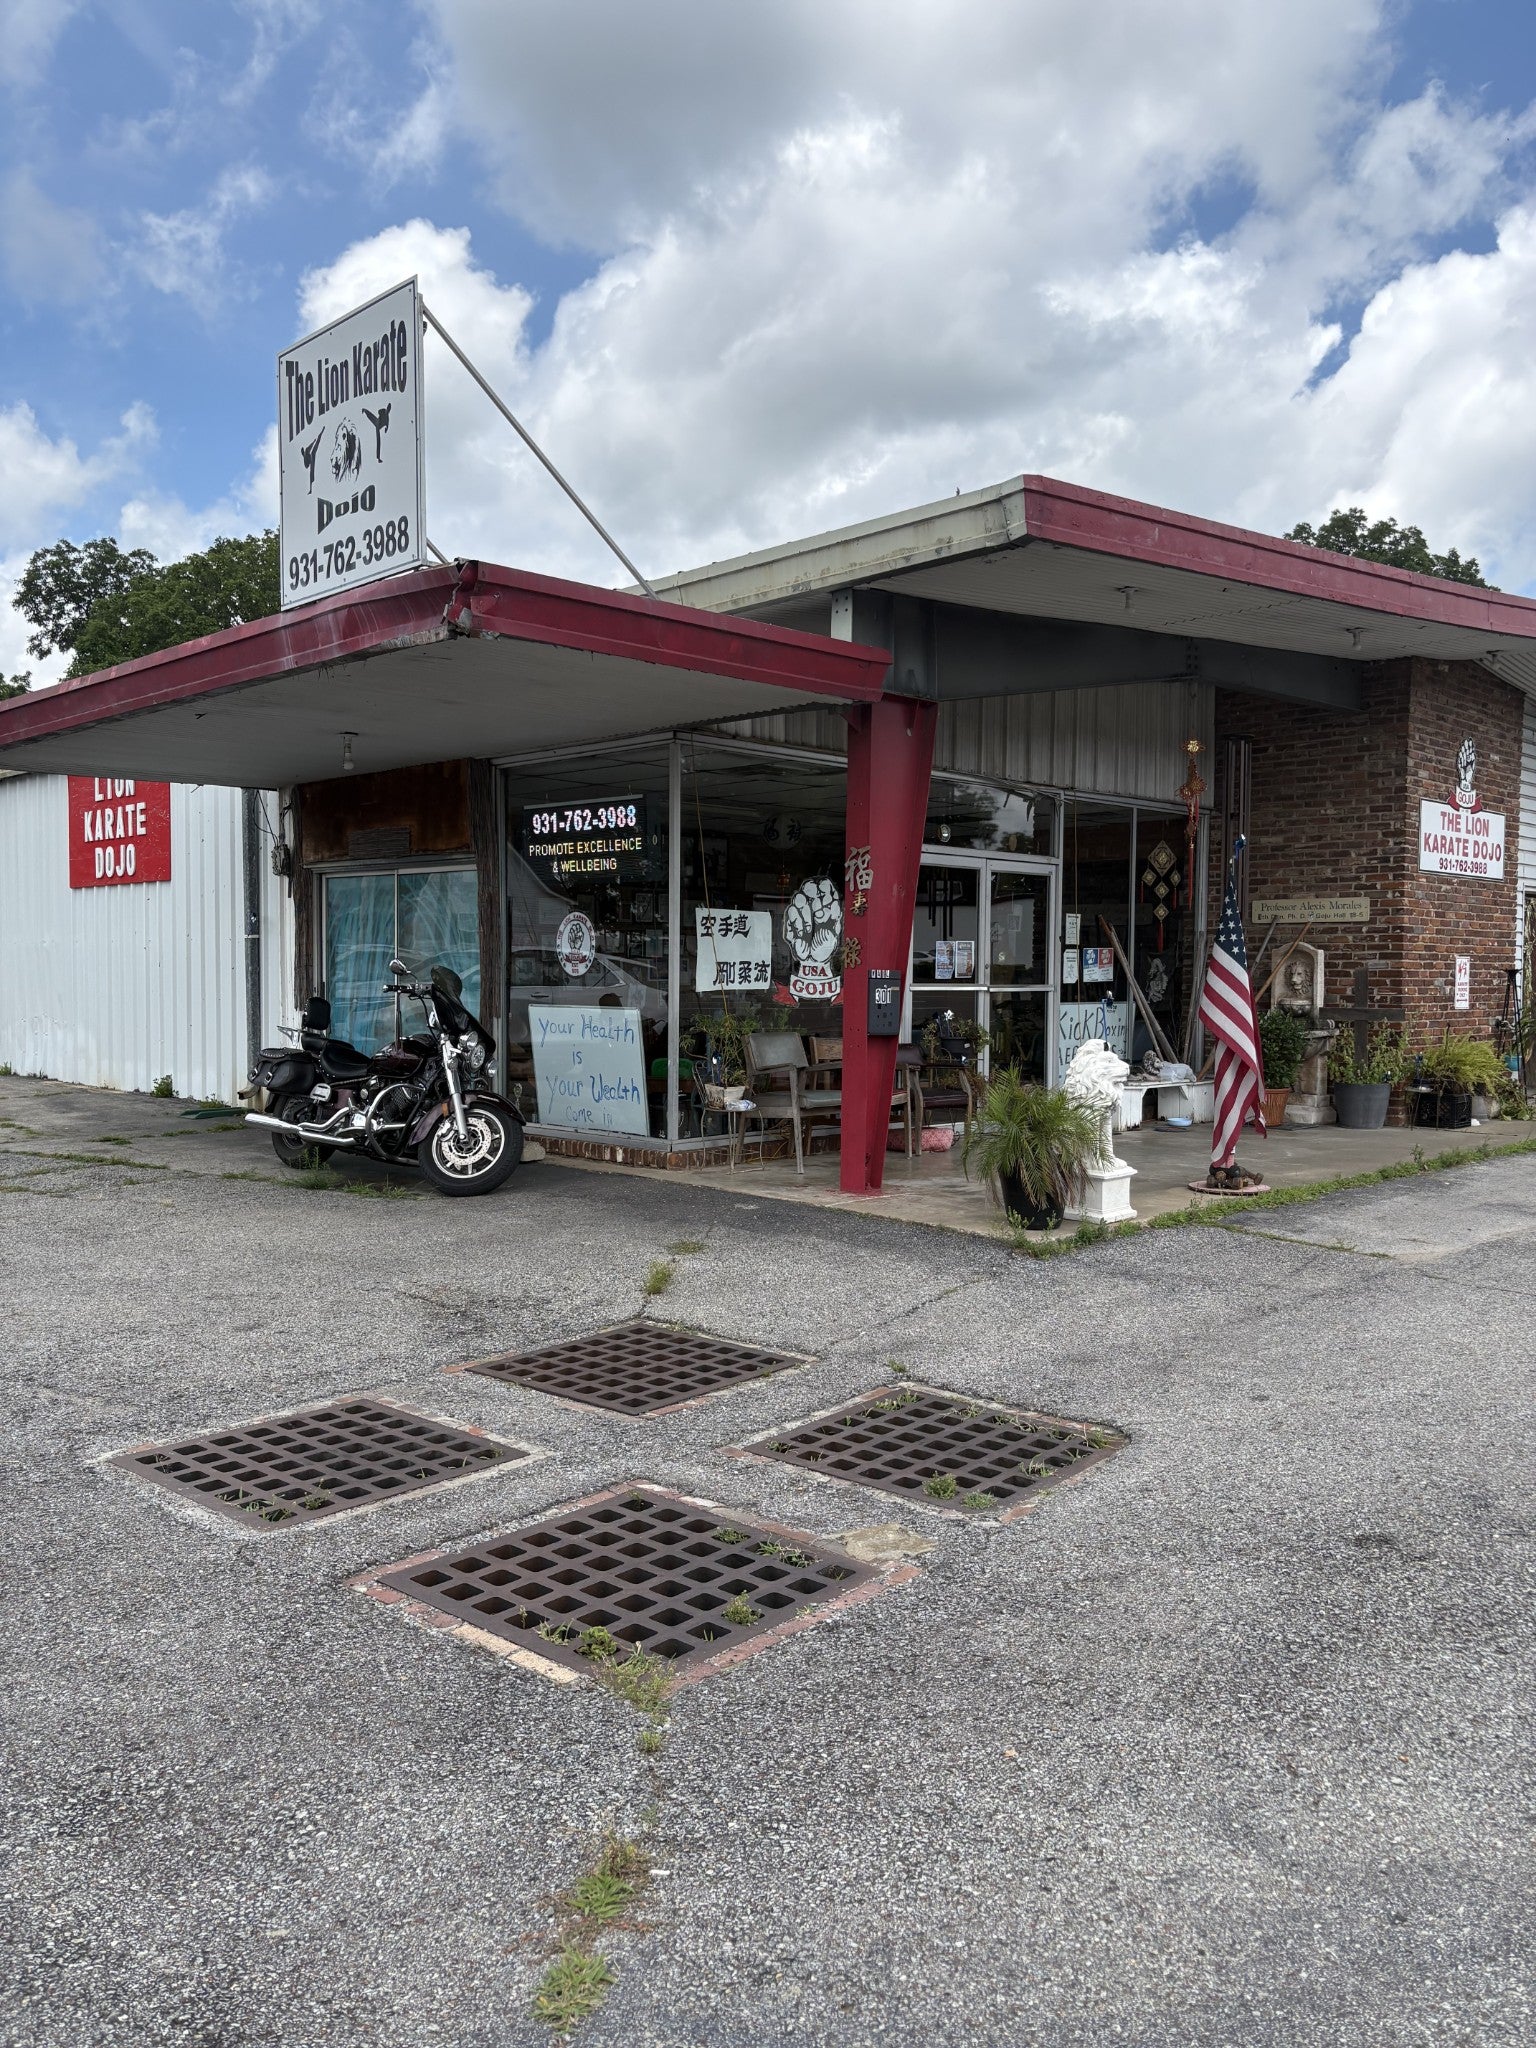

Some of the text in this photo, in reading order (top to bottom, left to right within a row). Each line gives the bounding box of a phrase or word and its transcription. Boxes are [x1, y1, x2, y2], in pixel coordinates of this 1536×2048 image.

[286, 319, 407, 442] The Lion Karate
[290, 515, 409, 591] 931-762-3988
[1458, 791, 1474, 805] GOJU
[84, 802, 146, 843] KARATE
[532, 805, 636, 835] 931-762-3988
[1440, 810, 1490, 838] THE LION
[529, 842, 575, 857] PROMOTE
[577, 837, 642, 854] EXCELLENCE
[1423, 832, 1502, 862] KARATE DOJO
[95, 843, 136, 879] DOJO
[552, 858, 617, 873] & WELLBEING
[1439, 857, 1488, 875] 931-762-3988
[1261, 900, 1362, 912] Professor Alexis Morales
[700, 914, 752, 940] 空手道
[802, 965, 829, 977] USA
[792, 979, 838, 996] GOJU
[875, 987, 892, 1004] 301
[572, 1043, 583, 1066] is
